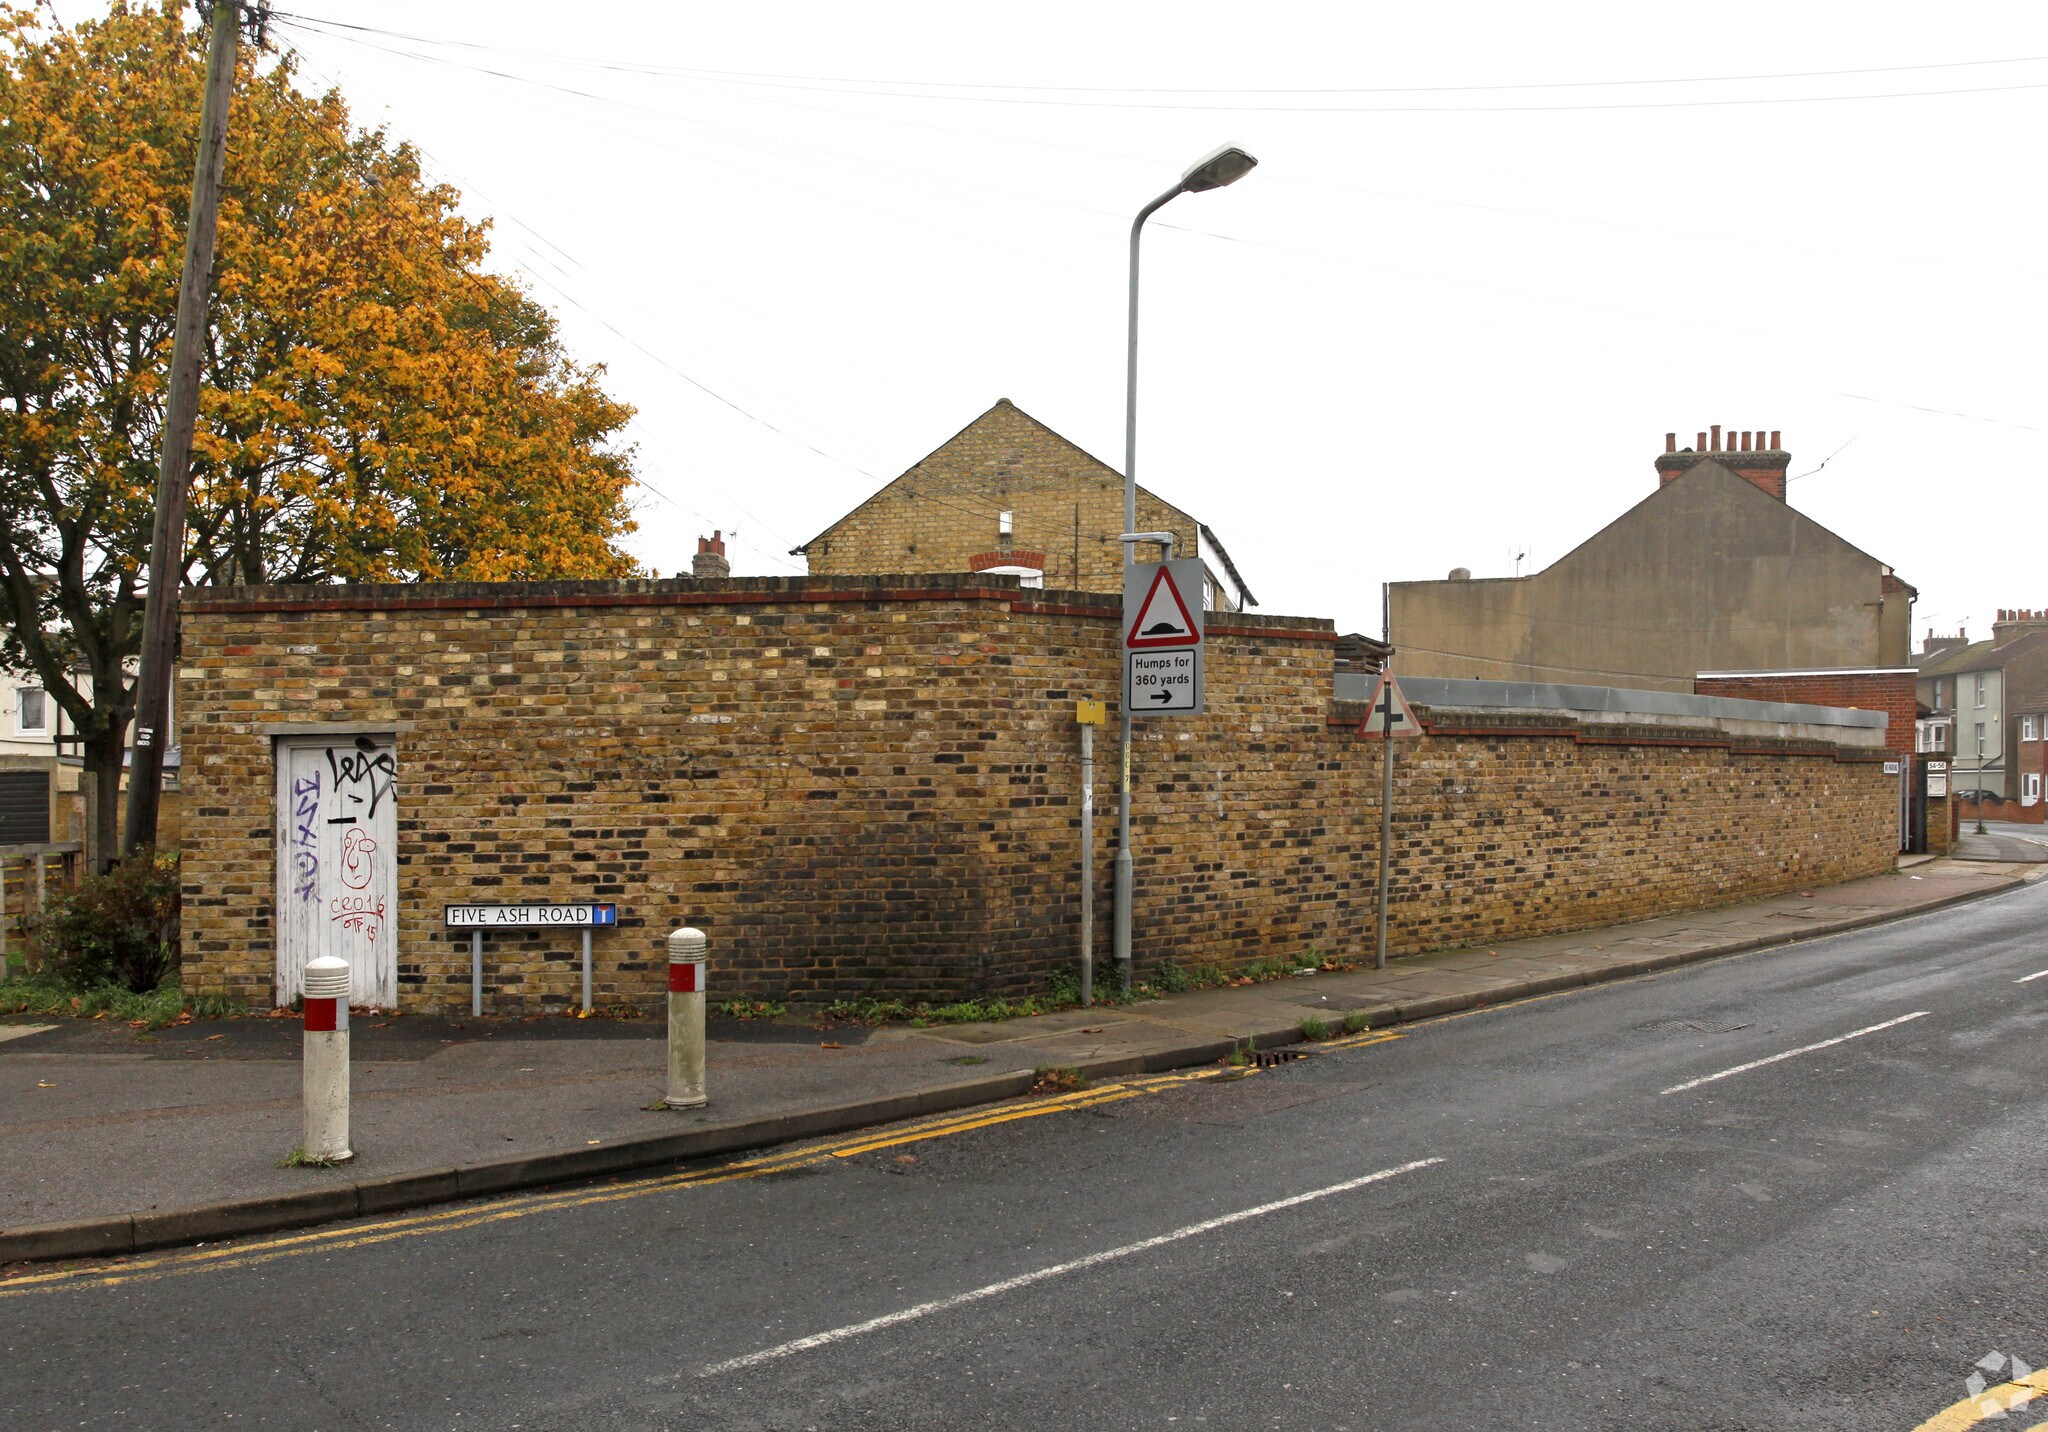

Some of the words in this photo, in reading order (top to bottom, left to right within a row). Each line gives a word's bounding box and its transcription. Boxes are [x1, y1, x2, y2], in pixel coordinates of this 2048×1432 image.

[1135, 658, 1171, 670] Humps
[1175, 656, 1190, 667] for
[1135, 674, 1157, 686] 360
[1160, 673, 1190, 687] yards
[452, 908, 487, 923] FIVE
[496, 908, 529, 923] ASH
[538, 907, 588, 923] ROAD
